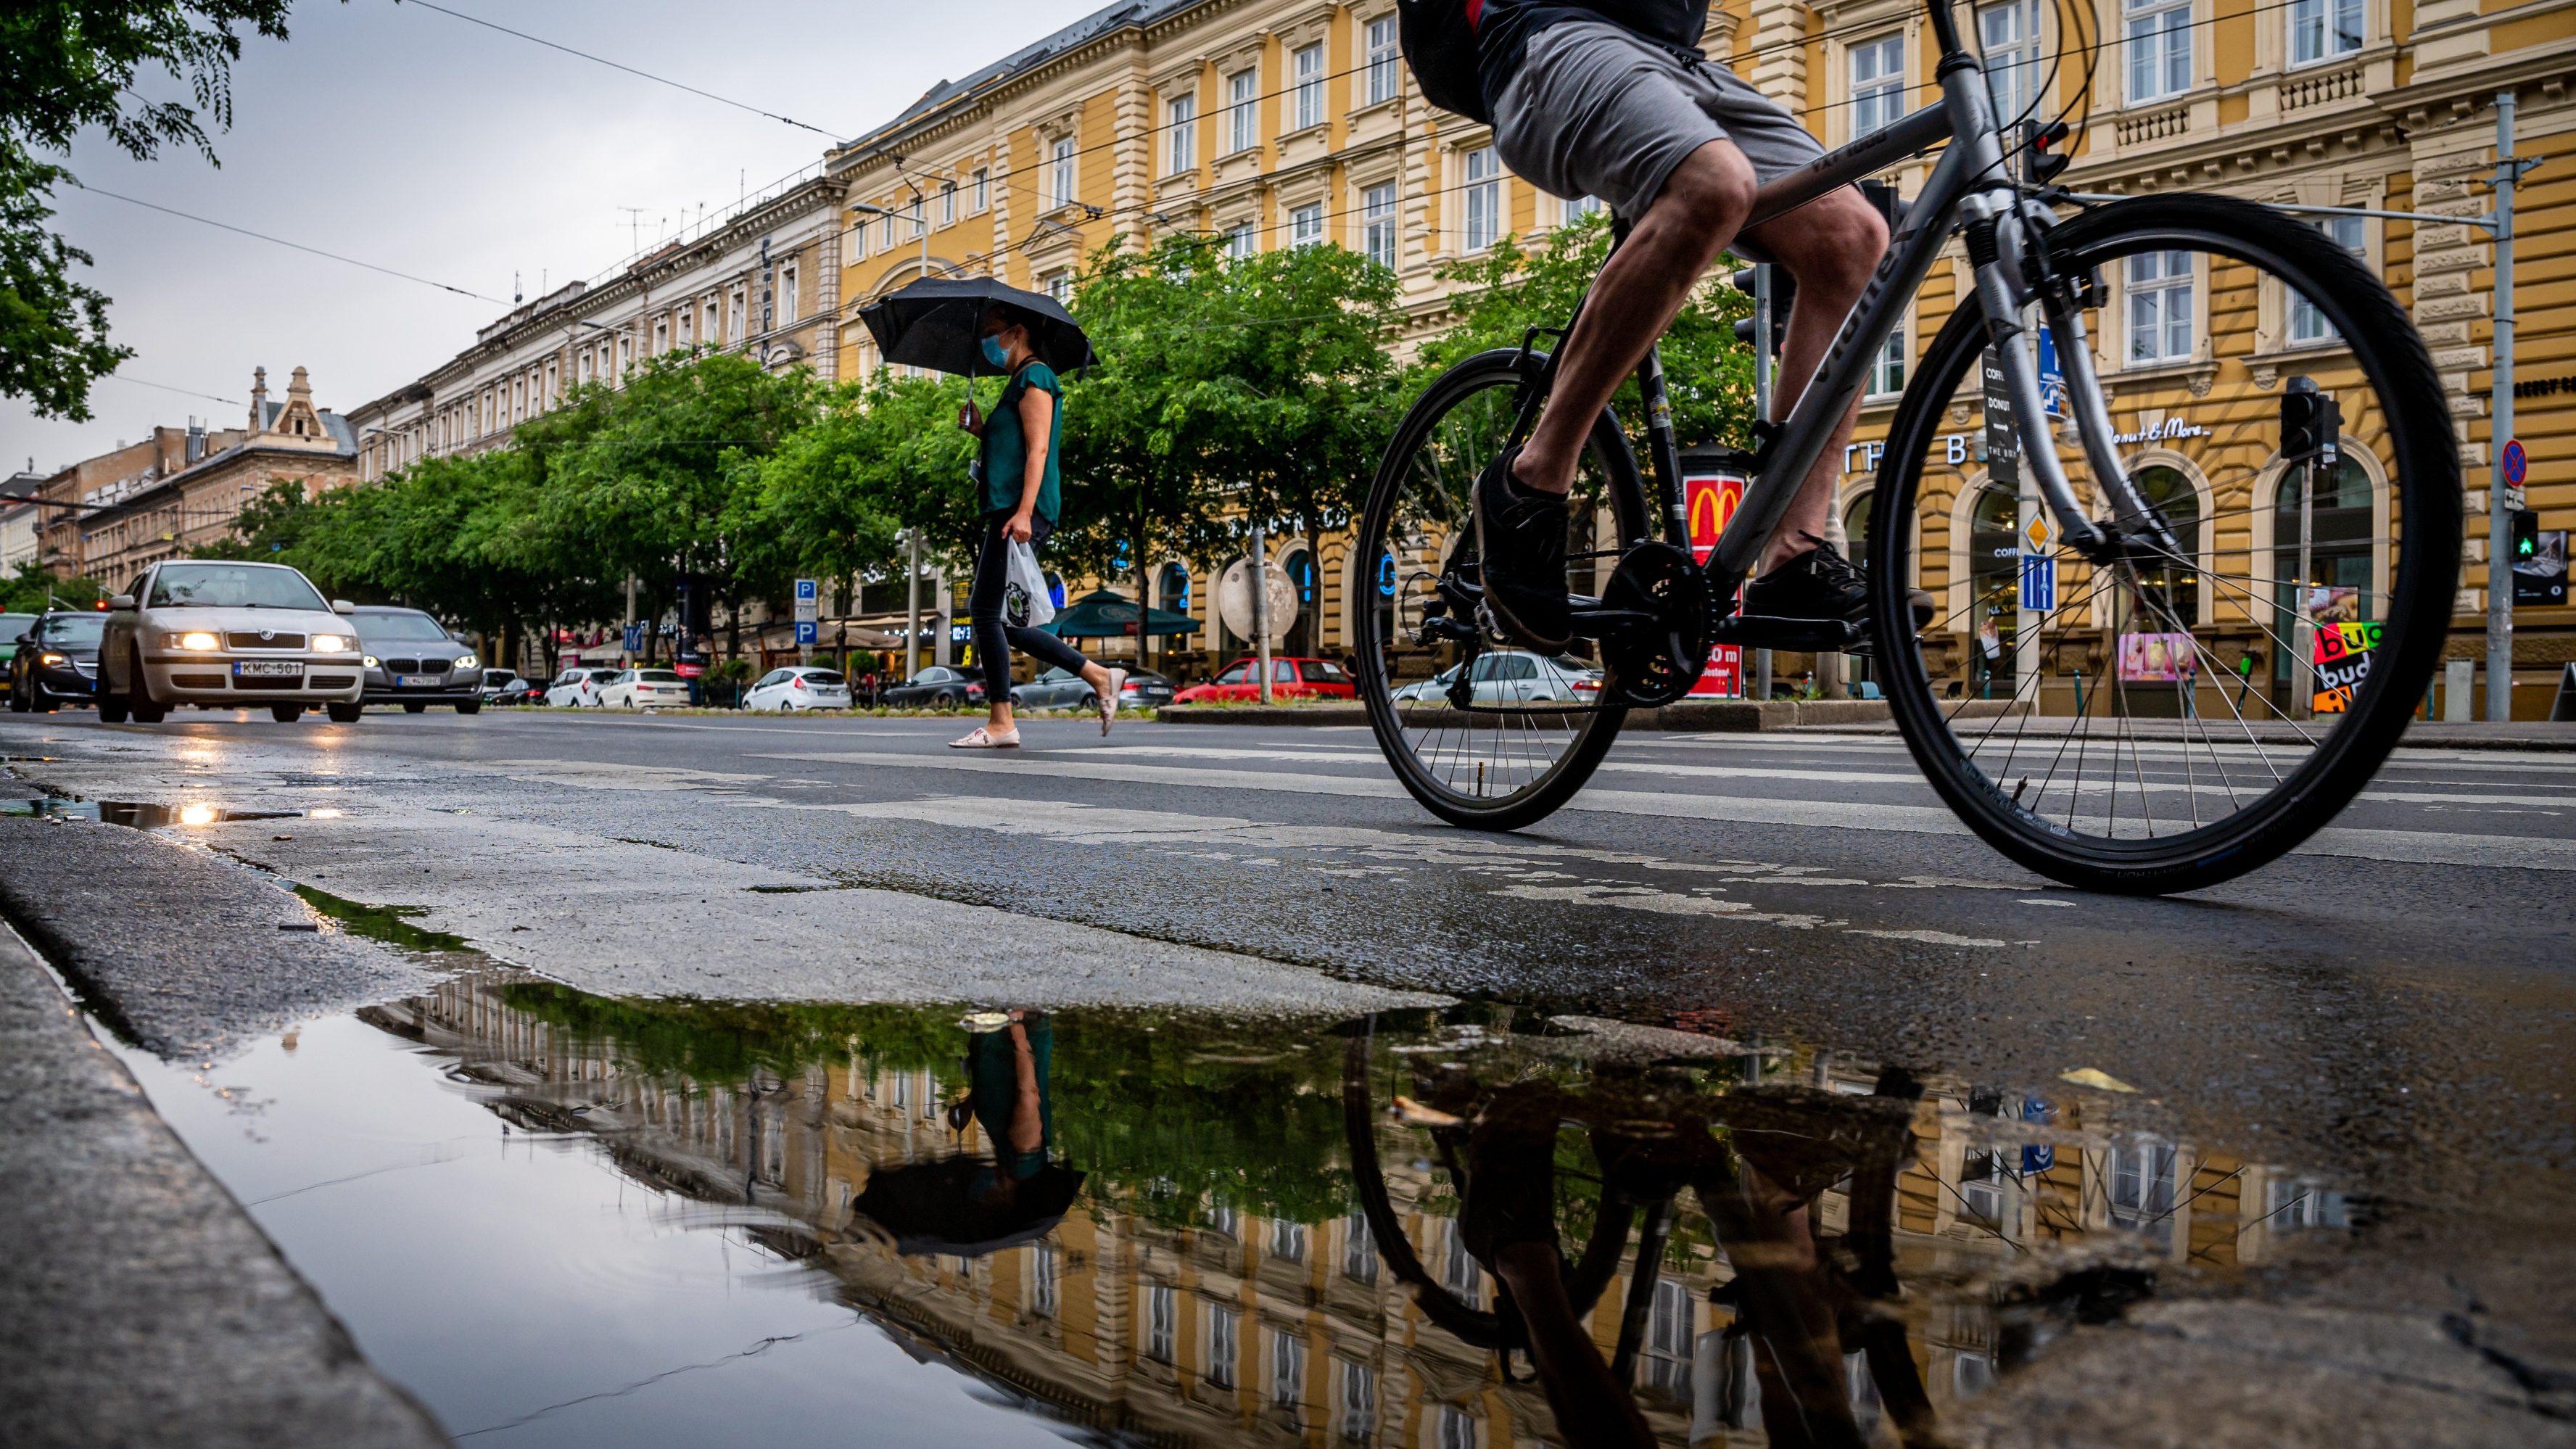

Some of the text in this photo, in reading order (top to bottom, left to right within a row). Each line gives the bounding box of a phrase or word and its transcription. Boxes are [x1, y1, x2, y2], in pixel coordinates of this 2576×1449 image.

[2148, 422, 2162, 440] &
[800, 624, 813, 642] P
[1725, 651, 1737, 663] m
[243, 664, 300, 674] KMC-501
